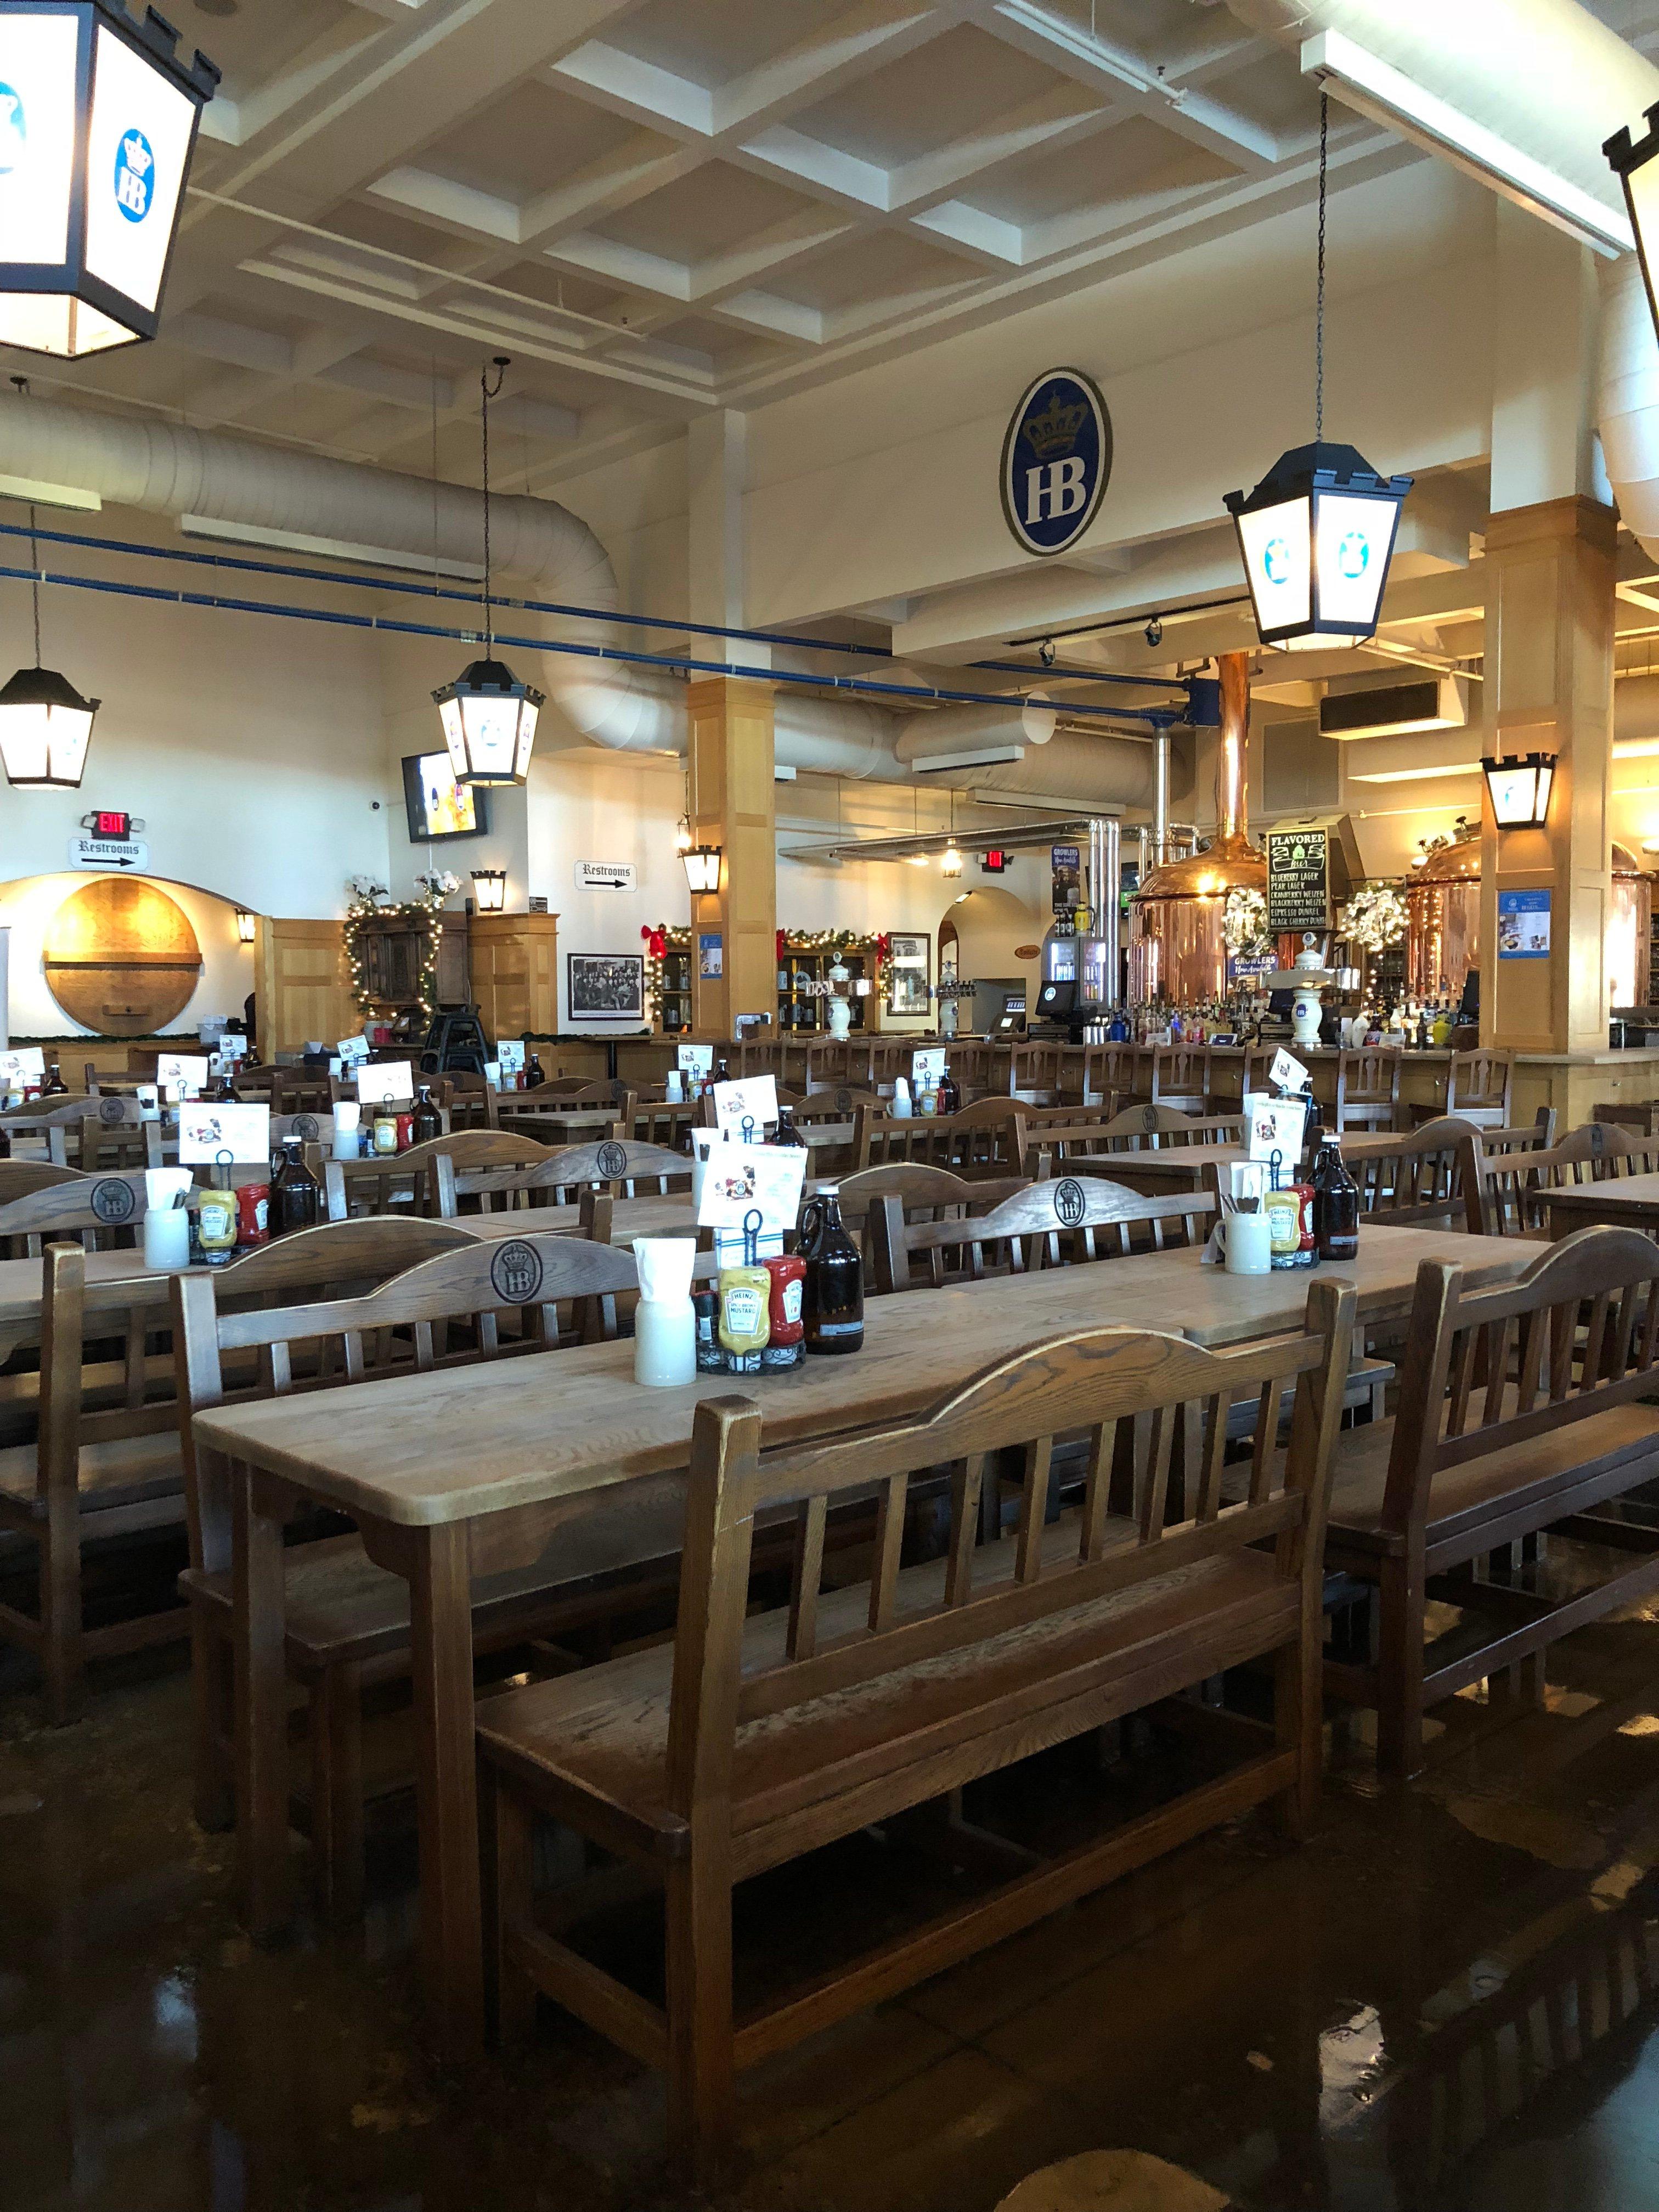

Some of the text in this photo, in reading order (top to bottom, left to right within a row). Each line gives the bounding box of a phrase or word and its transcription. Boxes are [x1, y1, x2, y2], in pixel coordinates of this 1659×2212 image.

[1025, 456, 1086, 524] HB
[99, 813, 125, 833] EXIT
[1271, 834, 1325, 846] FLAVORED
[78, 840, 139, 855] Restrooms
[583, 863, 630, 877] Restrooms
[1271, 872, 1319, 882] BLUEBERRY LAGER
[1271, 882, 1305, 891] PEAR LAGER
[1271, 907, 1319, 917] ESPRESSO DUNKEL
[1234, 956, 1276, 965] GROWLERS
[506, 1270, 531, 1294] HB
